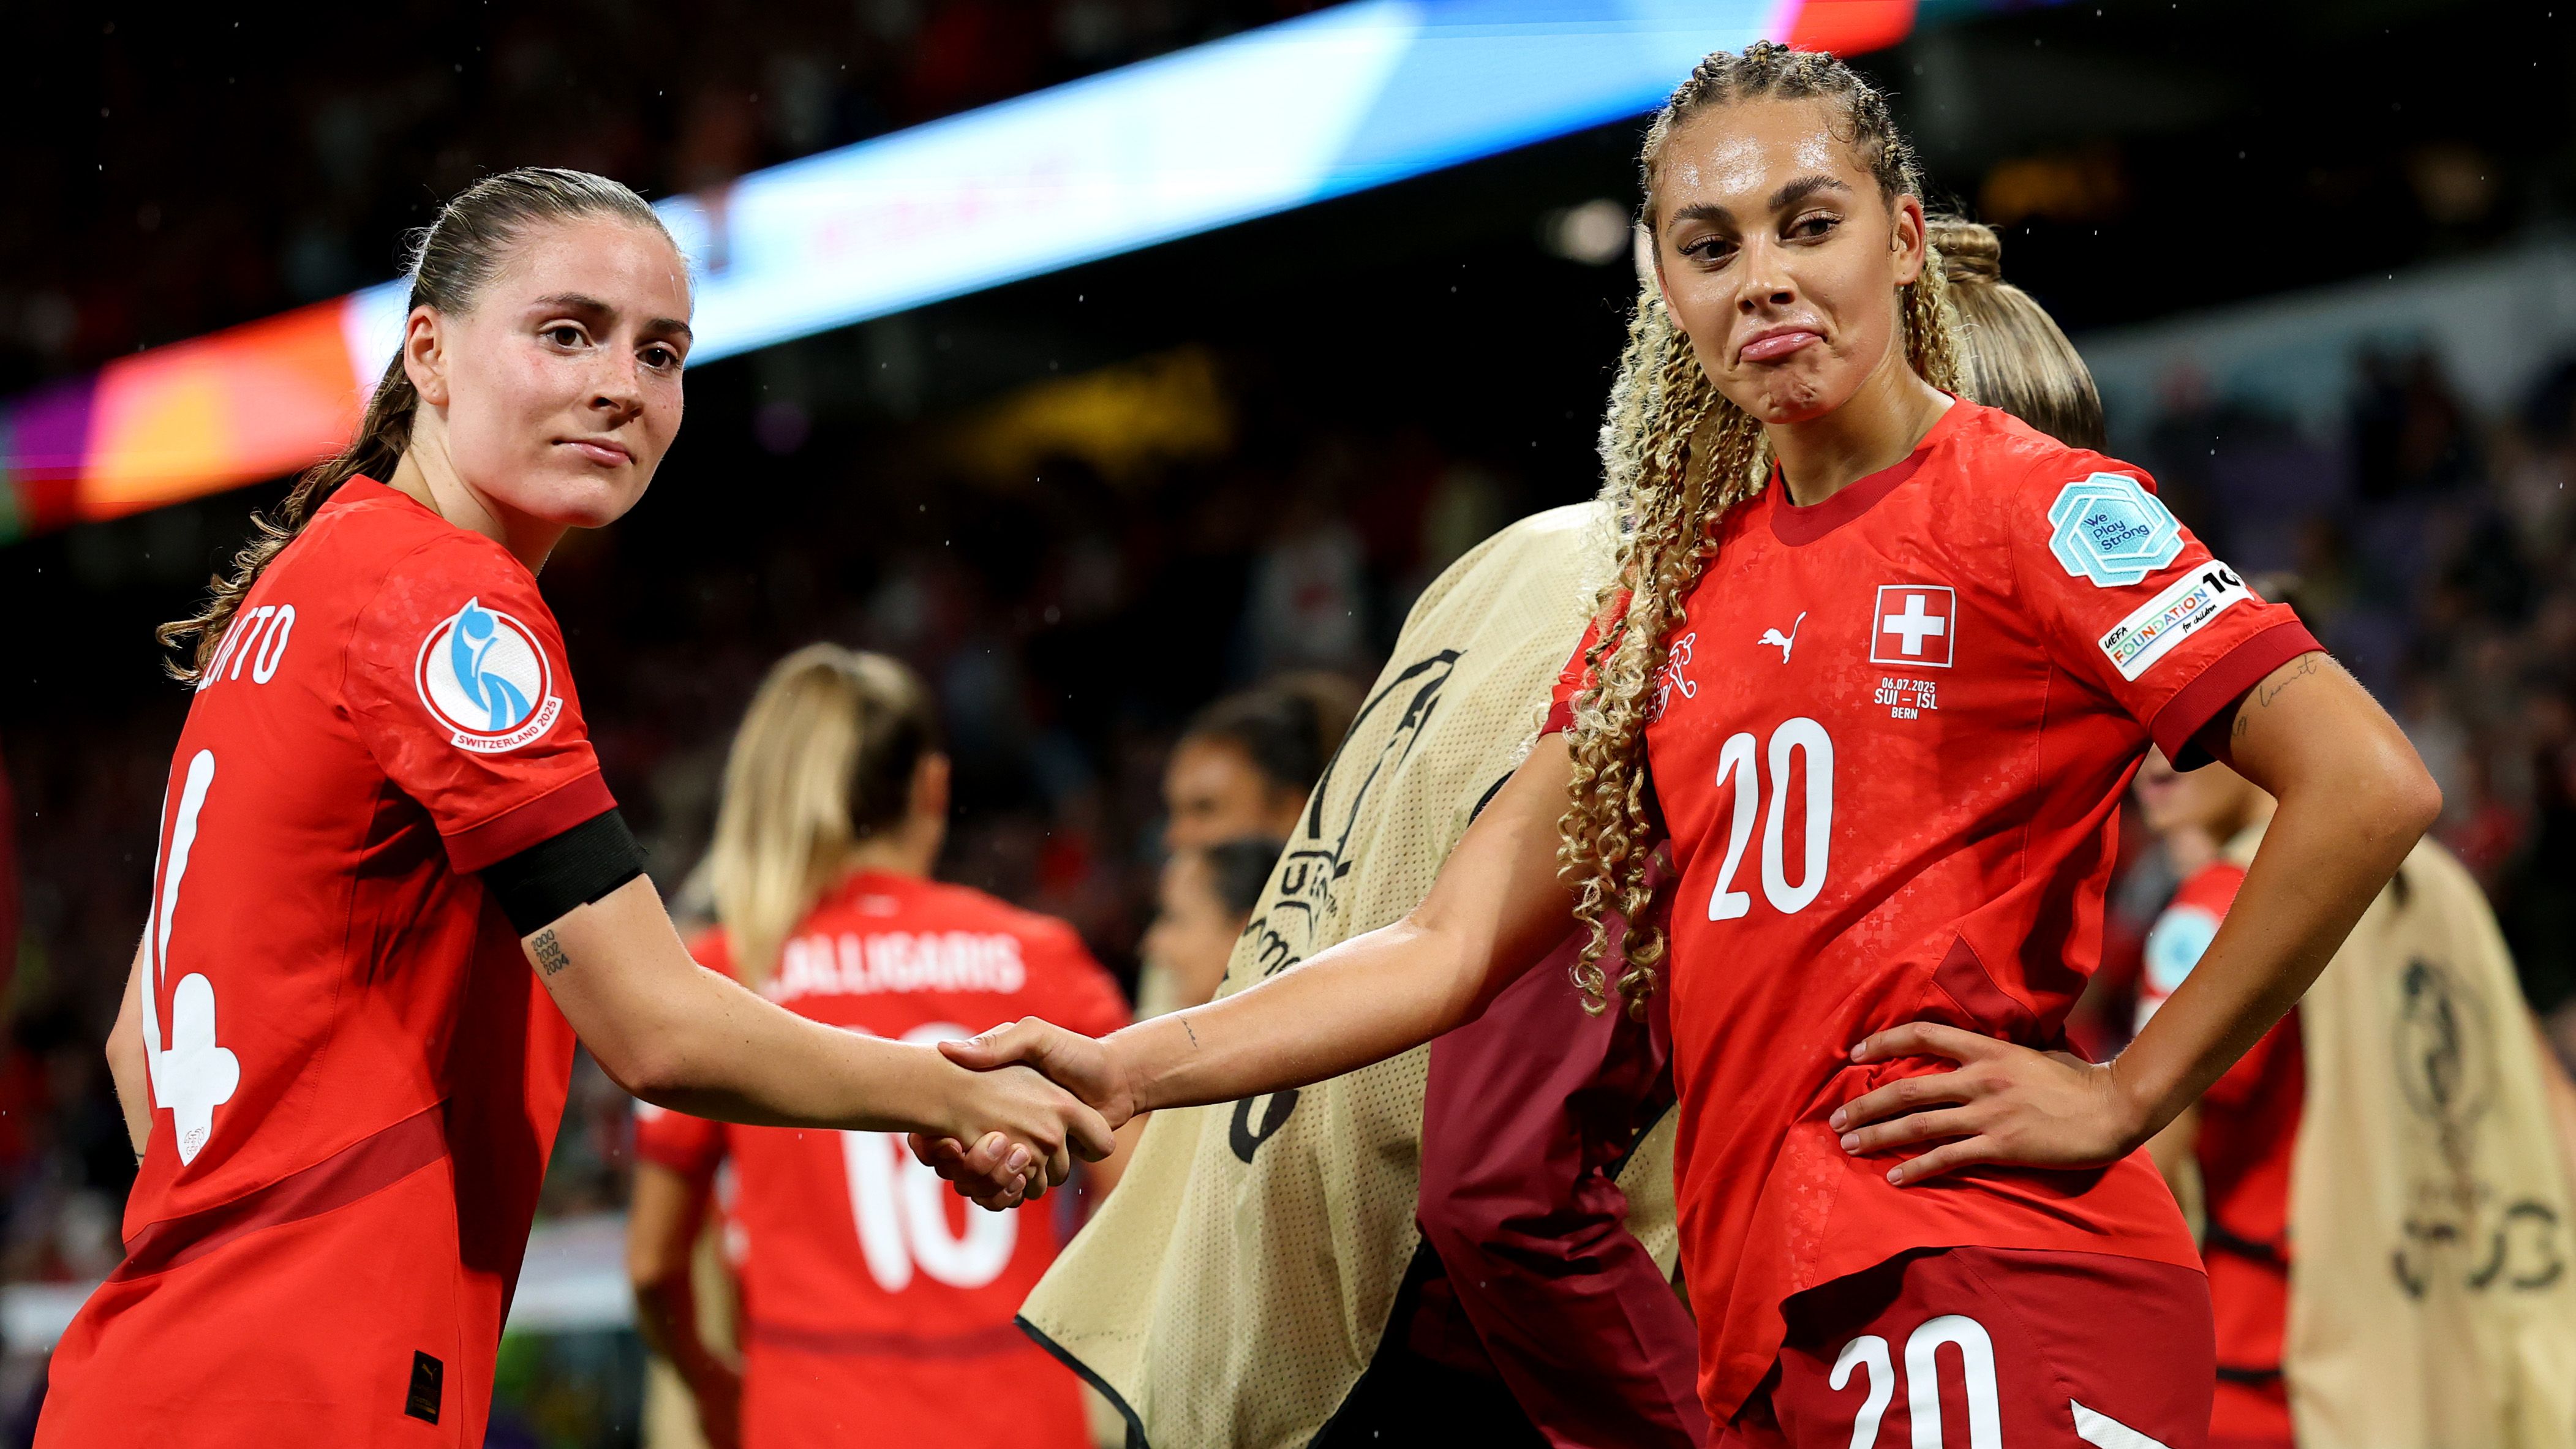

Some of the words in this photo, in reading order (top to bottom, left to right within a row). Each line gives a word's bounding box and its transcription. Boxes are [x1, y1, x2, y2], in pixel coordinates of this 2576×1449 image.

[2084, 514, 2108, 527] We
[2093, 520, 2126, 540] Play
[2101, 524, 2150, 551] Strong
[2182, 622, 2192, 634] for
[2194, 604, 2217, 625] children
[2104, 626, 2129, 649] UEFA
[1881, 677, 1936, 693] 06.07.2025
[1874, 688, 1899, 706] SUI
[1916, 692, 1938, 710] ISL
[458, 726, 539, 749] SWITZERLAND
[537, 699, 557, 728] 2025
[1891, 706, 1918, 720] BERN
[1708, 717, 1834, 921] 20
[767, 931, 1027, 1001] ALLIGARIS
[1829, 1314, 2003, 1449] 20
